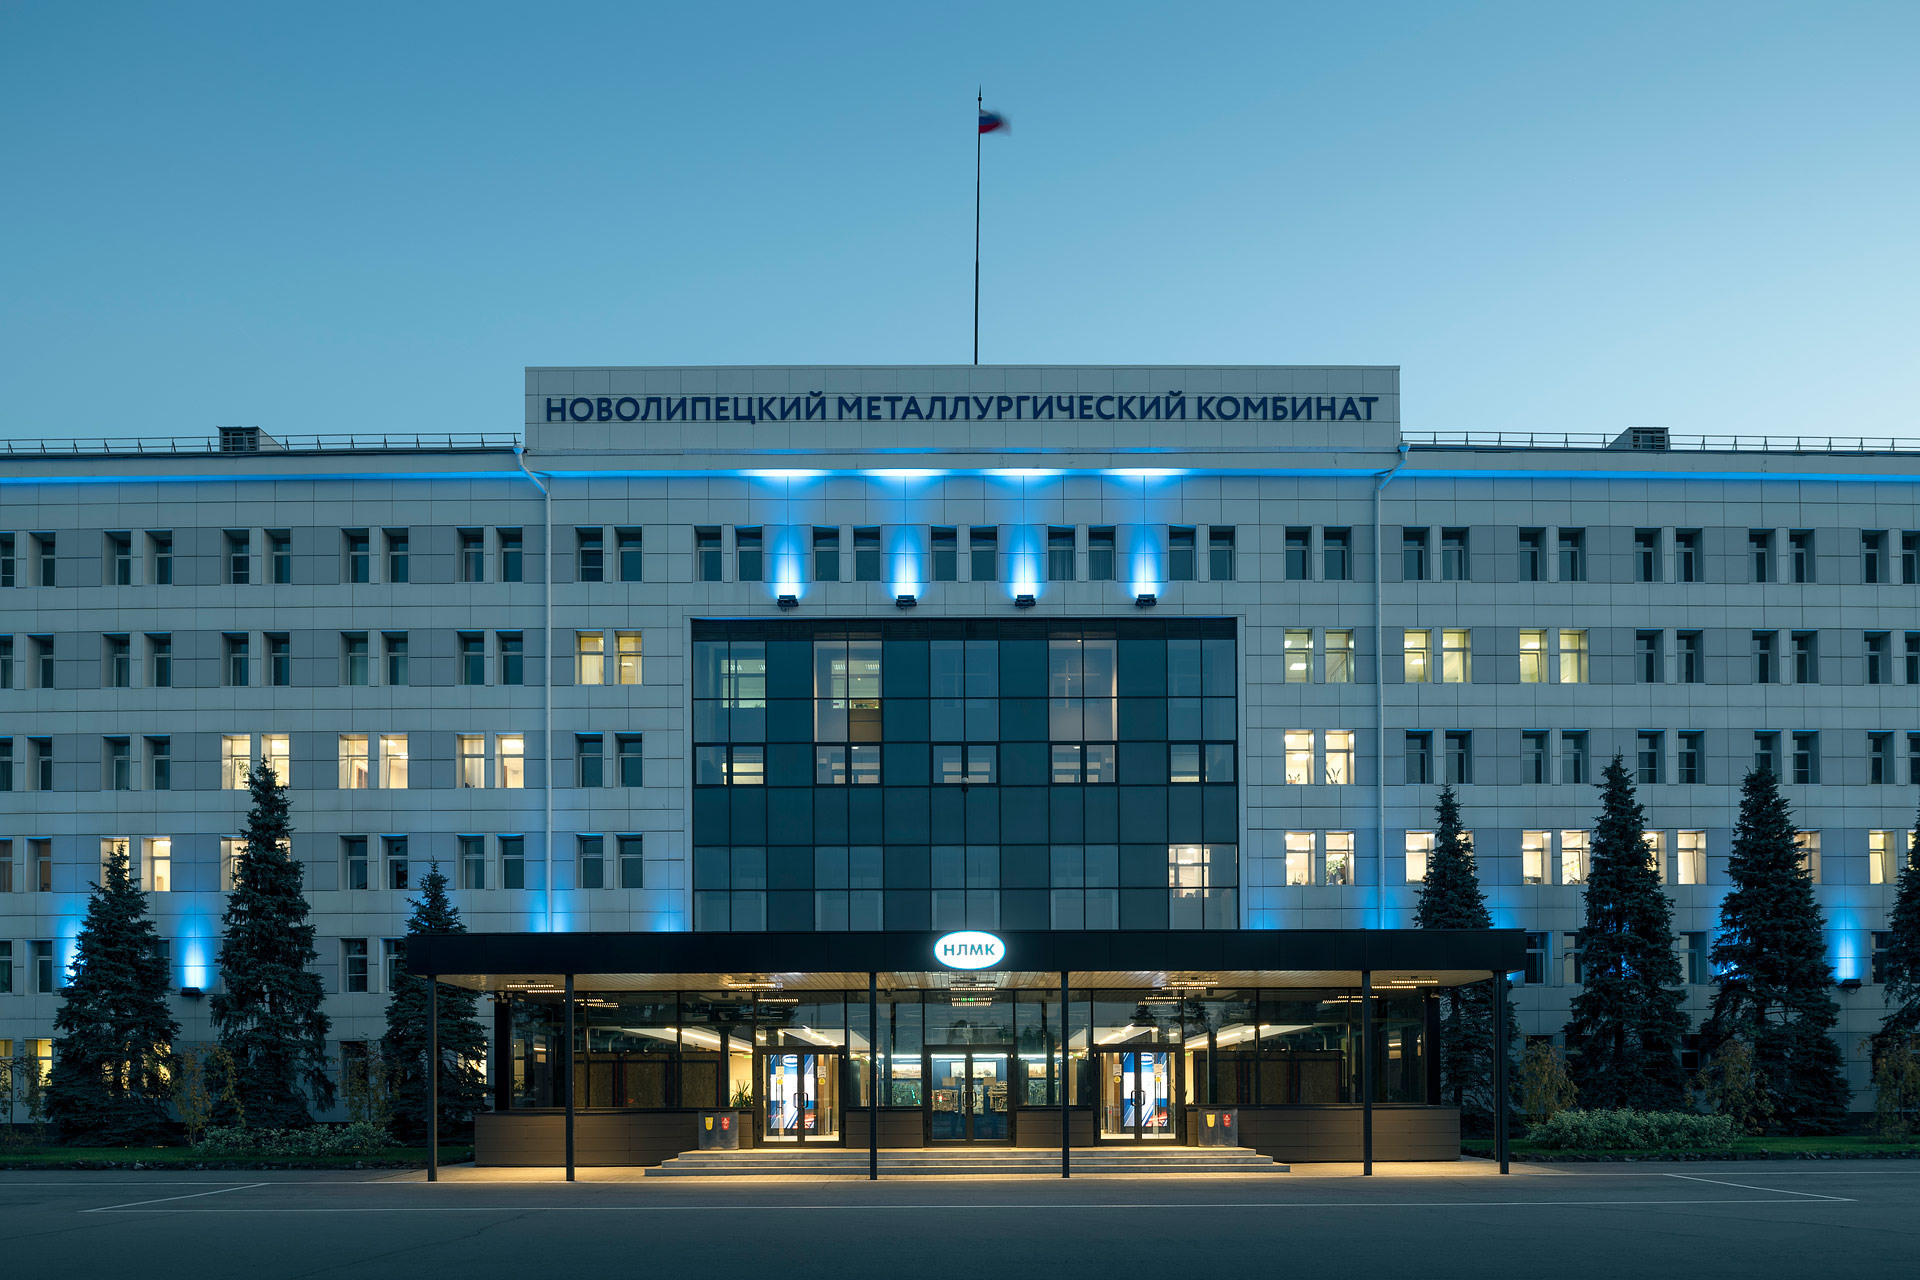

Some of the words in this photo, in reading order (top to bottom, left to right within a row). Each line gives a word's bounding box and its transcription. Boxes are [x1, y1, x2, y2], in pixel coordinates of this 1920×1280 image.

[546, 390, 827, 424] НОВОЛИПЕЦКИЙ
[837, 390, 1187, 421] МЕТАЛЛУРГИЧЕСКИЙ
[1197, 395, 1379, 421] КОМБИНАТ
[943, 944, 996, 956] НЛМК
